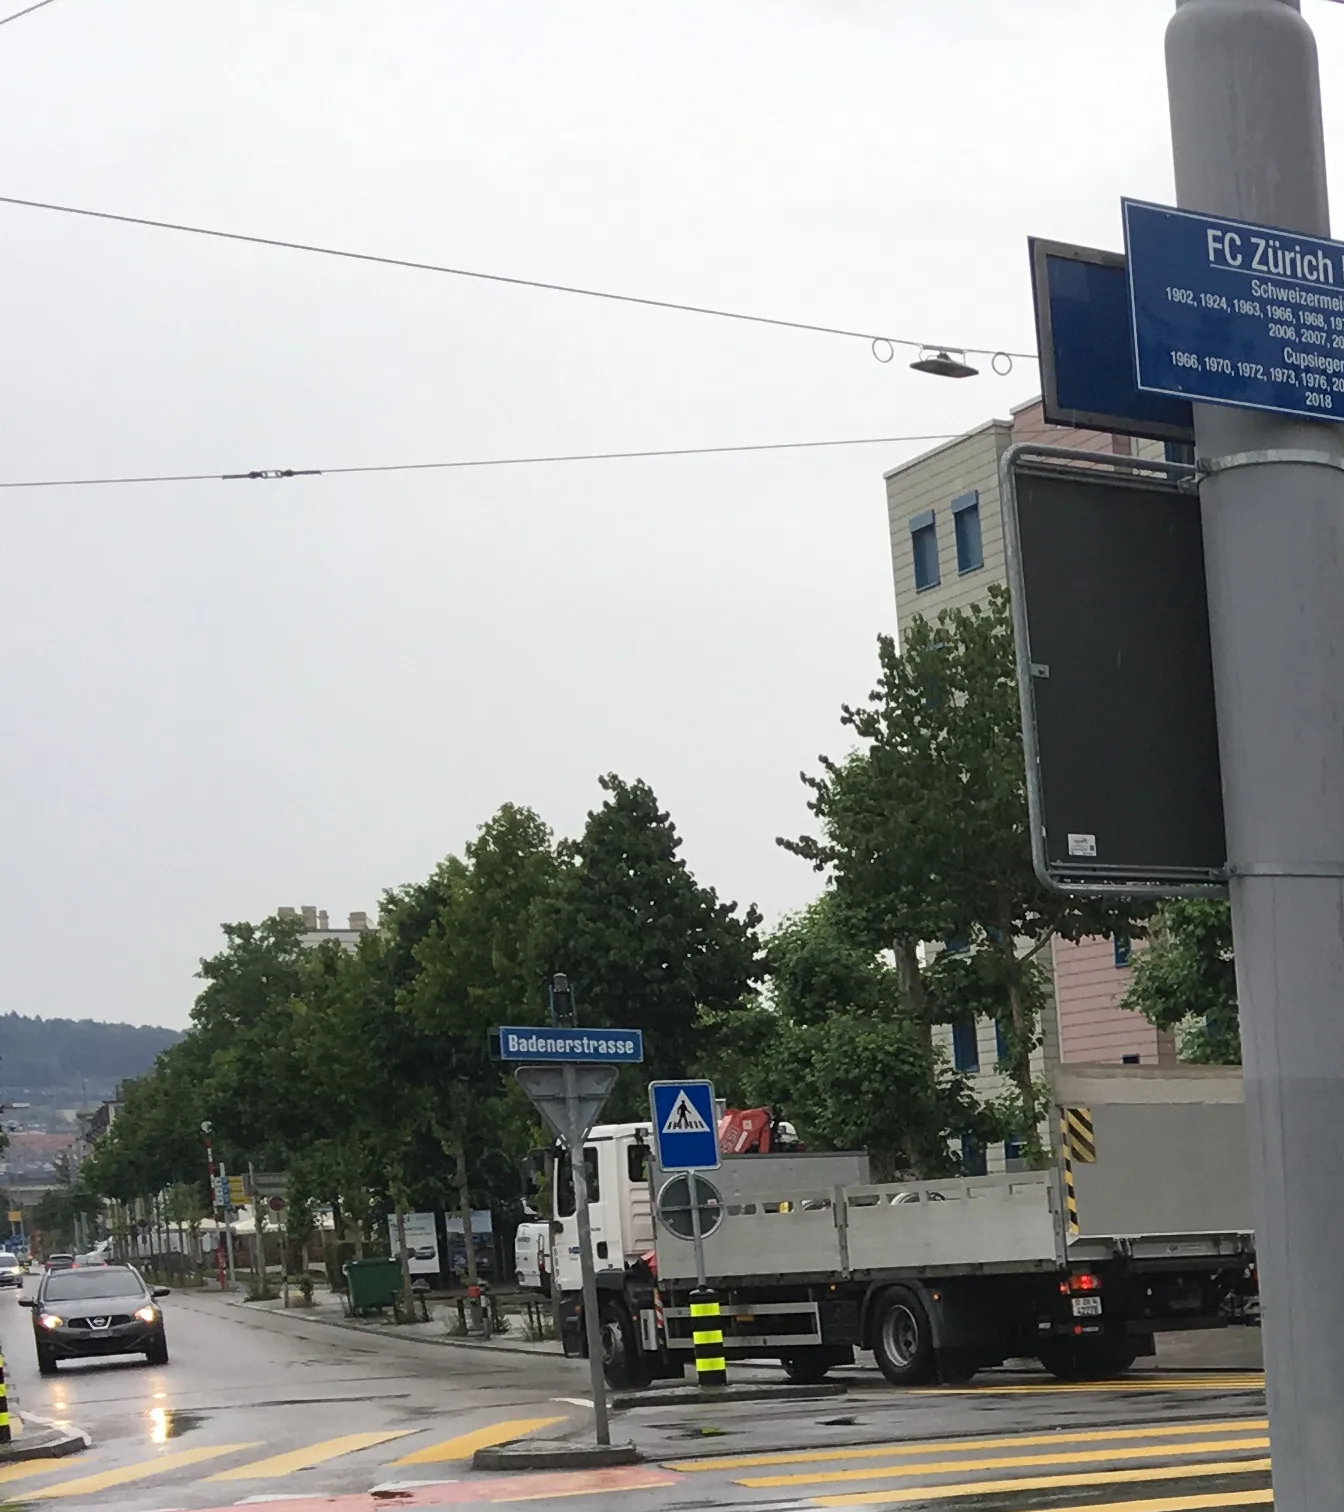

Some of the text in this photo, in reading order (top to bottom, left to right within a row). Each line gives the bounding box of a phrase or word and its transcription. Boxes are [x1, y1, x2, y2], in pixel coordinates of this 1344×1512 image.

[1206, 228, 1242, 266] FC
[1250, 237, 1334, 284] Zürich
[1166, 286, 1198, 307] 1902,
[1200, 292, 1231, 313] 1924,
[1233, 299, 1263, 319] 1963,
[1266, 305, 1296, 325] 1966,
[1298, 311, 1328, 330] 1968,
[1268, 323, 1299, 343] 2006,
[1300, 328, 1331, 349] 2007,
[1170, 350, 1202, 372] 1966,
[1204, 356, 1235, 377] 1970,
[1237, 362, 1267, 382] 1972,
[1269, 367, 1299, 388] 1973,
[1301, 372, 1331, 392] 1976,
[1283, 347, 1344, 374] Cupsieger
[1305, 391, 1333, 409] 2018
[507, 1034, 634, 1054] Badenerstrasse
